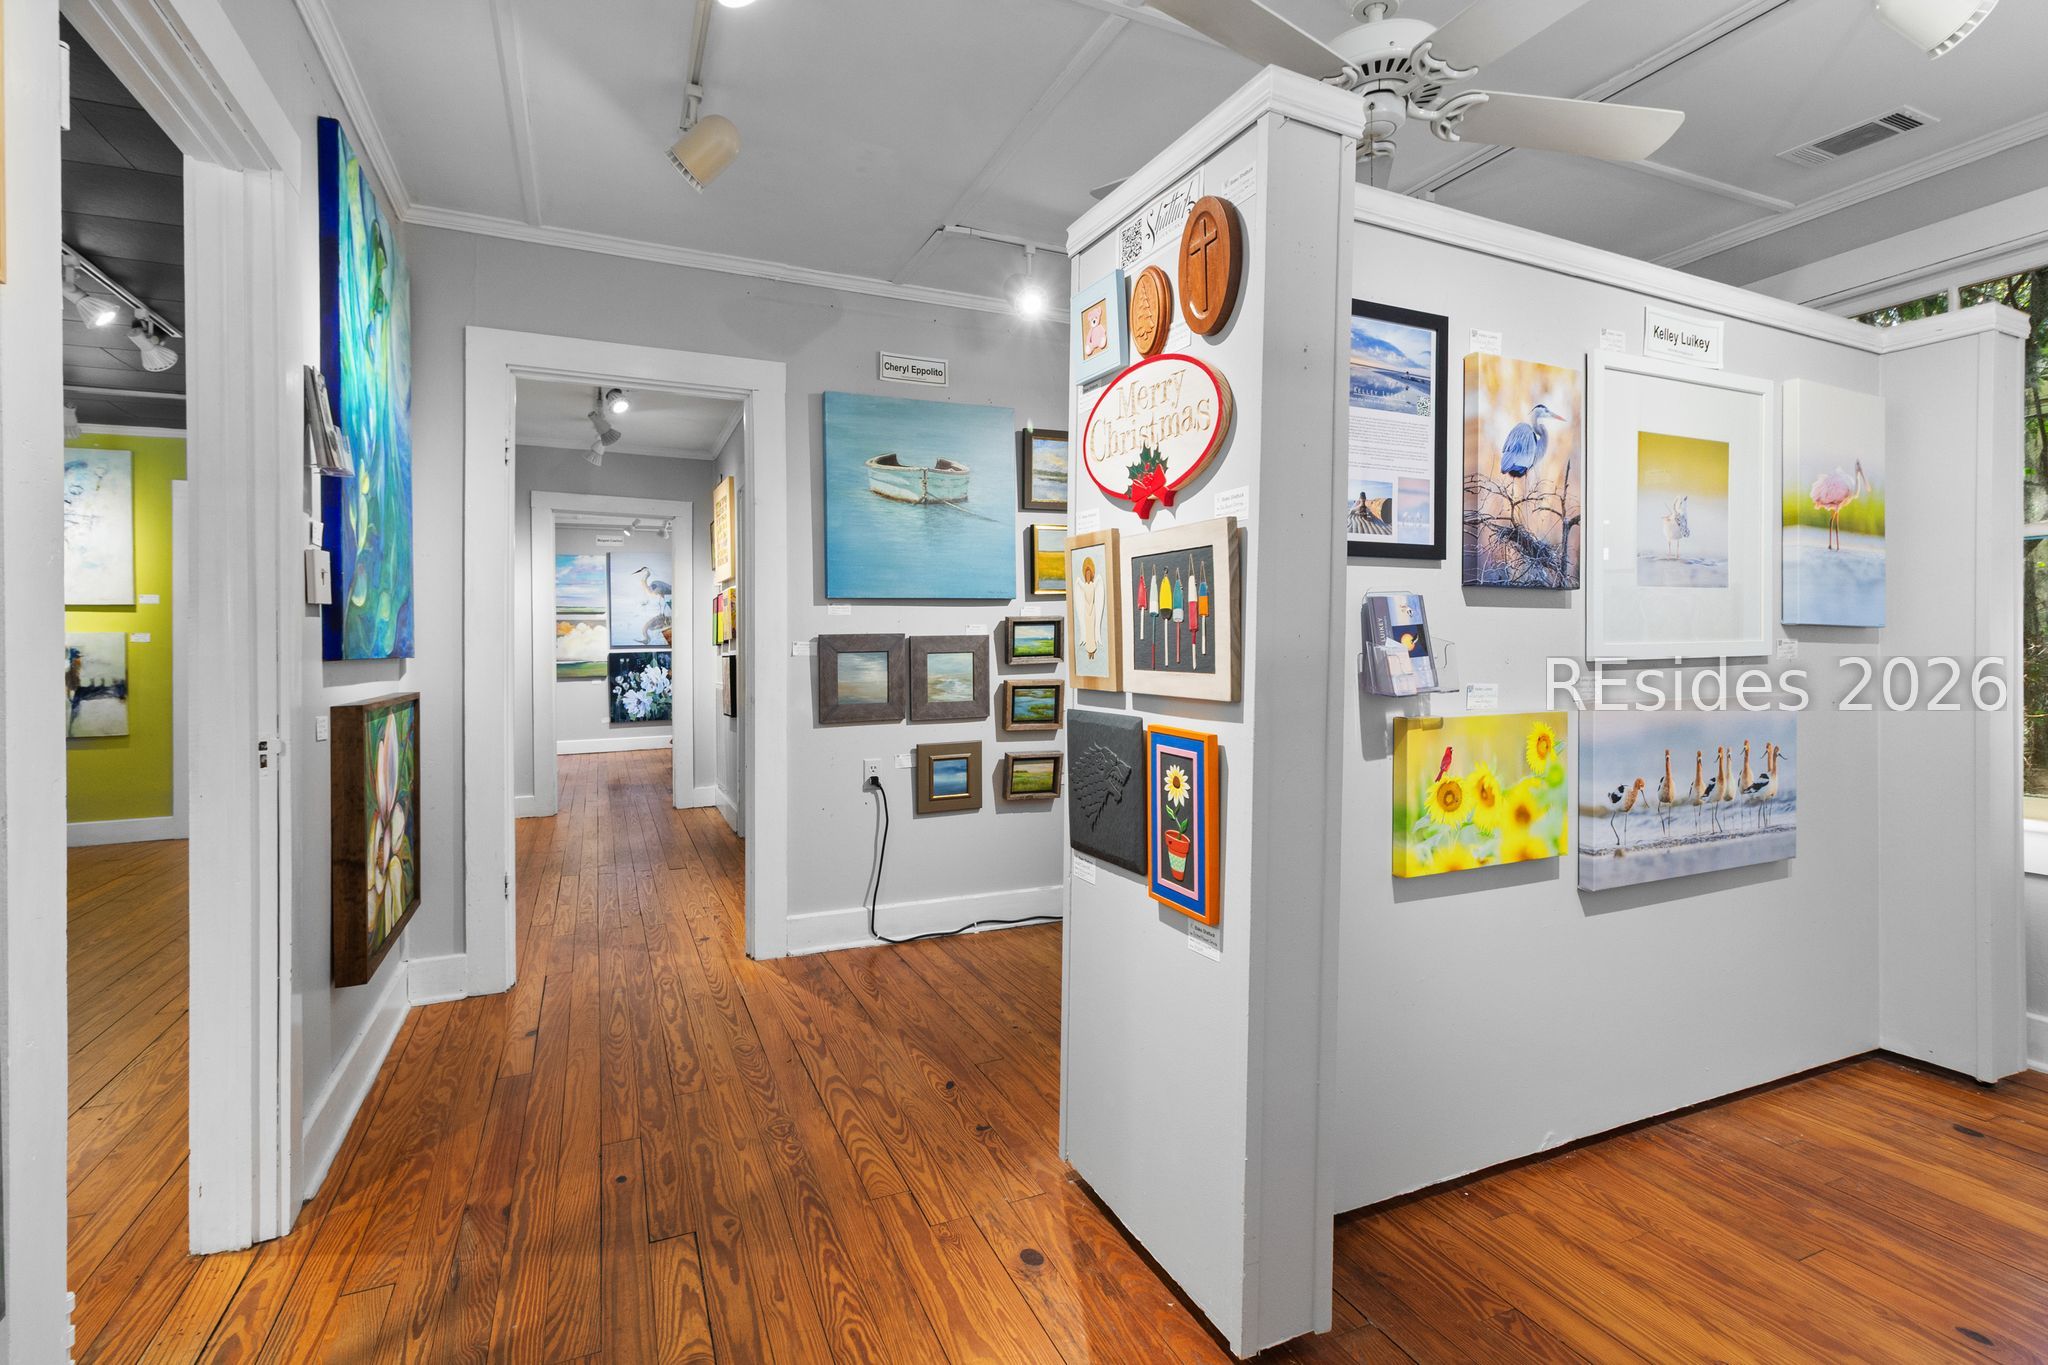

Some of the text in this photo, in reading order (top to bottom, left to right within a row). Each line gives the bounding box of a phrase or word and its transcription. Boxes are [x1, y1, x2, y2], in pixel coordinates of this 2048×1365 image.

[1653, 325, 1710, 352] Kelley Luikey
[884, 361, 943, 376] Cheryl Eppolito
[1116, 368, 1187, 420] Merry
[1089, 398, 1212, 462] Christmas
[1376, 617, 1386, 642] LUIKEY
